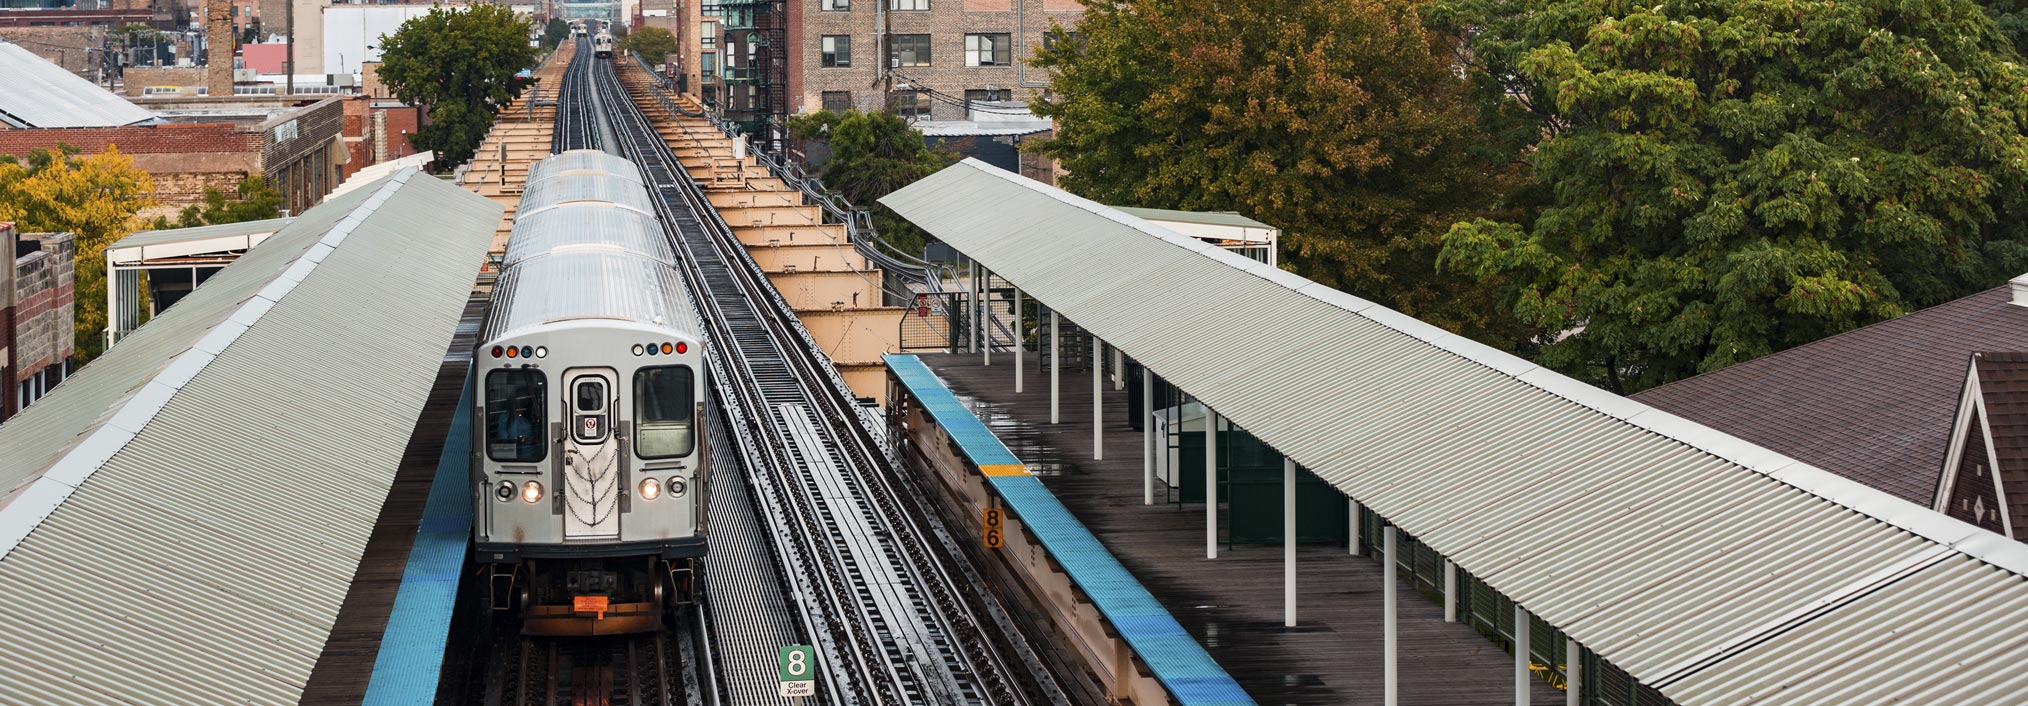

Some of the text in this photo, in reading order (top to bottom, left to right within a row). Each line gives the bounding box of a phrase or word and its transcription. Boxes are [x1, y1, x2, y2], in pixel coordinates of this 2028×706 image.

[987, 510, 999, 526] 8
[987, 530, 999, 546] 6
[788, 650, 806, 676] 8
